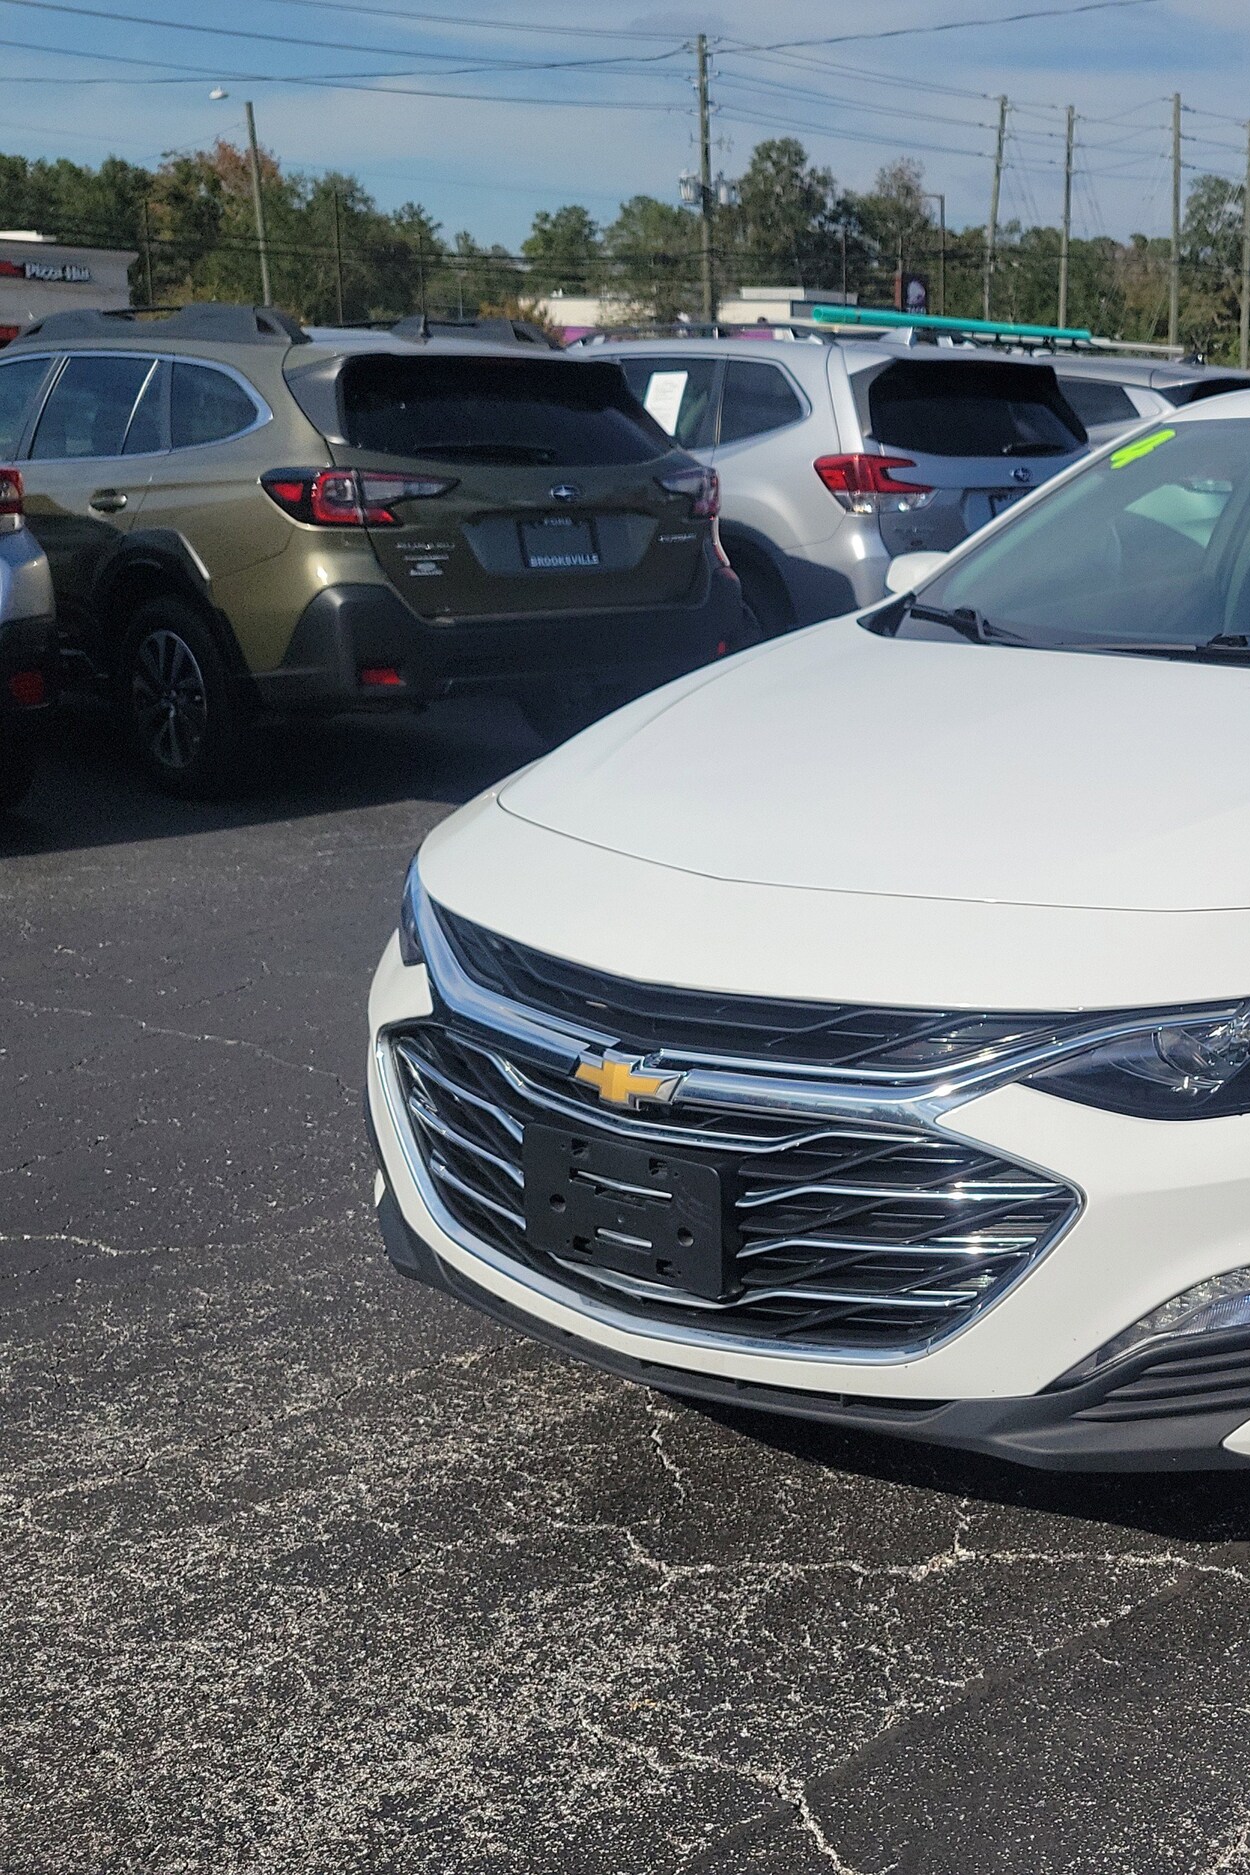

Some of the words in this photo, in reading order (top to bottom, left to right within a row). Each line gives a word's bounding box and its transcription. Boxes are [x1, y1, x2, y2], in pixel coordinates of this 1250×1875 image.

[25, 262, 62, 280] Pizza
[64, 264, 90, 281] Hut
[530, 553, 599, 568] BROOKSVILLE
